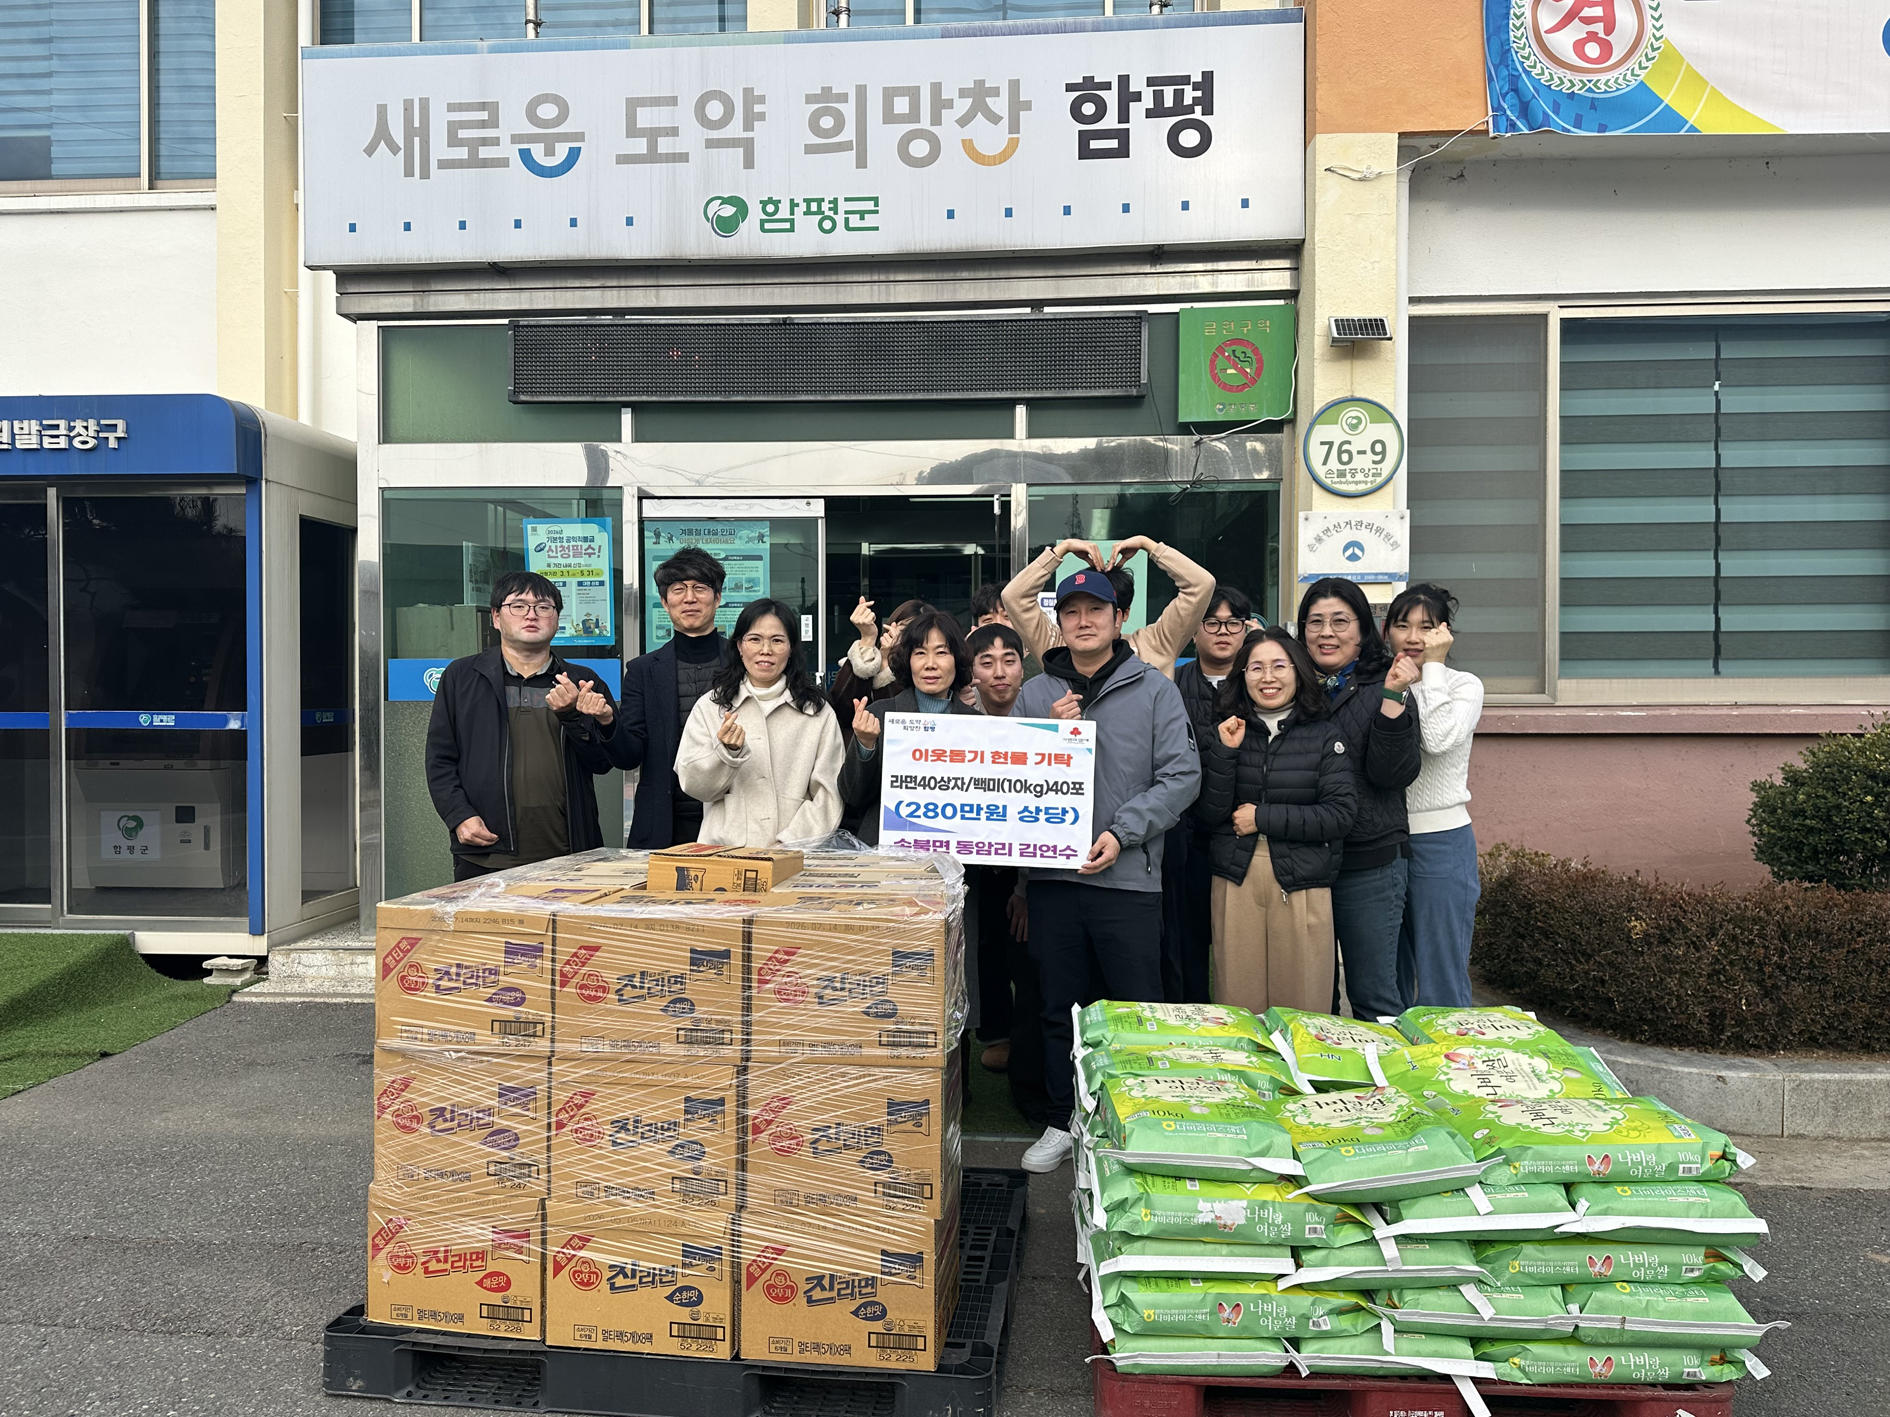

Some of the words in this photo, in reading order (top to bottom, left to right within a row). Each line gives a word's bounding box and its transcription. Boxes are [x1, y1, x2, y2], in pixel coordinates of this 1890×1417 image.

[363, 92, 585, 179] 새로운
[615, 87, 767, 170] 도약
[804, 78, 1032, 169] 희망찬
[1065, 71, 1214, 160] 함평
[759, 196, 880, 234] 함평군
[1320, 439, 1387, 466] 76-9
[1324, 467, 1382, 479] 손불중앙길
[679, 528, 702, 537] 겨울철
[1306, 519, 1401, 553] 손불면선거관리위원회
[546, 544, 602, 559] 신청필수!
[911, 748, 985, 764] 이웃돕기
[990, 750, 1029, 766] 현물
[1034, 752, 1073, 768] 기탁
[889, 774, 1085, 798] 라면40상자/백미(10kg)40포
[894, 800, 1008, 822] (280만원
[1017, 804, 1080, 826] 상당)
[113, 844, 149, 855] 함평군
[955, 840, 1013, 857] 동암리
[1018, 843, 1079, 860] 김연수
[384, 938, 411, 969] 멀티팩
[433, 962, 500, 996] 진라면
[615, 970, 687, 1005] 진라면
[427, 1104, 494, 1137] 진라면
[1151, 1109, 1185, 1119] 10kg
[608, 1115, 680, 1150] 진라면
[1176, 1124, 1247, 1135] 나비라이스센터
[1325, 1137, 1360, 1147] 10kg
[1355, 1135, 1426, 1154] 나비라이스센터
[1617, 1150, 1657, 1166] 나비랑
[1520, 1165, 1578, 1174] 나비라이스센터
[1630, 1163, 1666, 1178] 여문쌀
[1631, 1186, 1708, 1198] 나비라이스센터
[1246, 1207, 1283, 1224] 나비랑
[1305, 1211, 1326, 1225] 10kg
[1256, 1223, 1293, 1238] 여문쌀
[393, 1257, 413, 1267] 오뚜기
[421, 1246, 488, 1278] 진라면
[1619, 1251, 1659, 1268] 나비랑
[606, 1260, 678, 1294] 진라면
[1520, 1265, 1579, 1274] 나비라이스센터
[1632, 1265, 1669, 1280] 여문쌀
[482, 1276, 507, 1289] 매운맛
[574, 1273, 597, 1284] 오뚜기
[672, 1290, 699, 1304] 순한맛
[769, 1287, 792, 1298] 오뚜기
[803, 1272, 878, 1307] 진라면
[1630, 1283, 1706, 1297] 나비라이스센터
[857, 1305, 883, 1318] 순한맛
[1250, 1300, 1288, 1318] 나비랑
[1155, 1313, 1210, 1322] 나비라이스센터
[1260, 1316, 1297, 1331] 여문쌀
[504, 1324, 523, 1332] 228
[679, 1343, 693, 1351] 52
[695, 1344, 715, 1352] 225
[878, 1353, 892, 1361] 52
[895, 1354, 916, 1362] 225
[1620, 1353, 1661, 1369] 나비랑
[1632, 1367, 1671, 1382] 여문쌀
